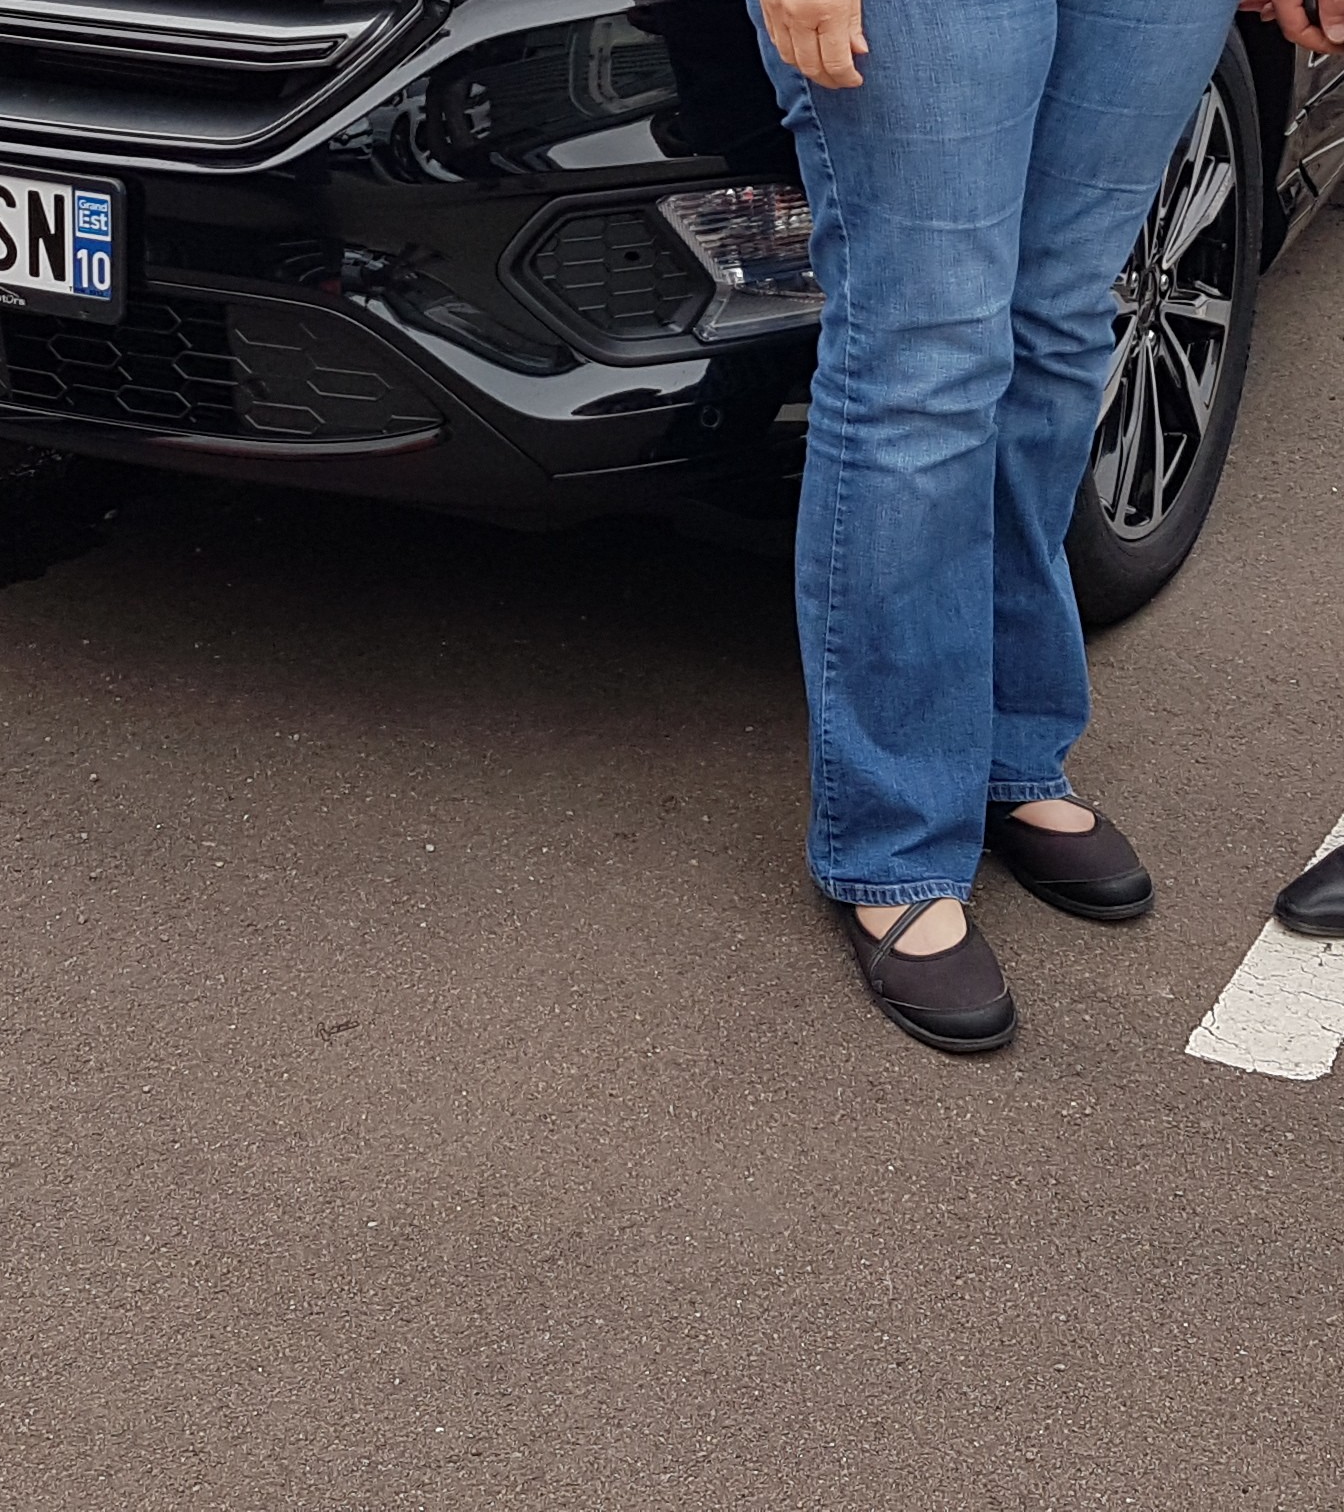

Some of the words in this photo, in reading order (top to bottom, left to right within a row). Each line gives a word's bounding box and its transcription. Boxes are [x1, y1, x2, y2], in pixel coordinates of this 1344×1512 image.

[79, 199, 108, 212] Grand
[79, 209, 108, 231] Est
[77, 248, 112, 291] 10
